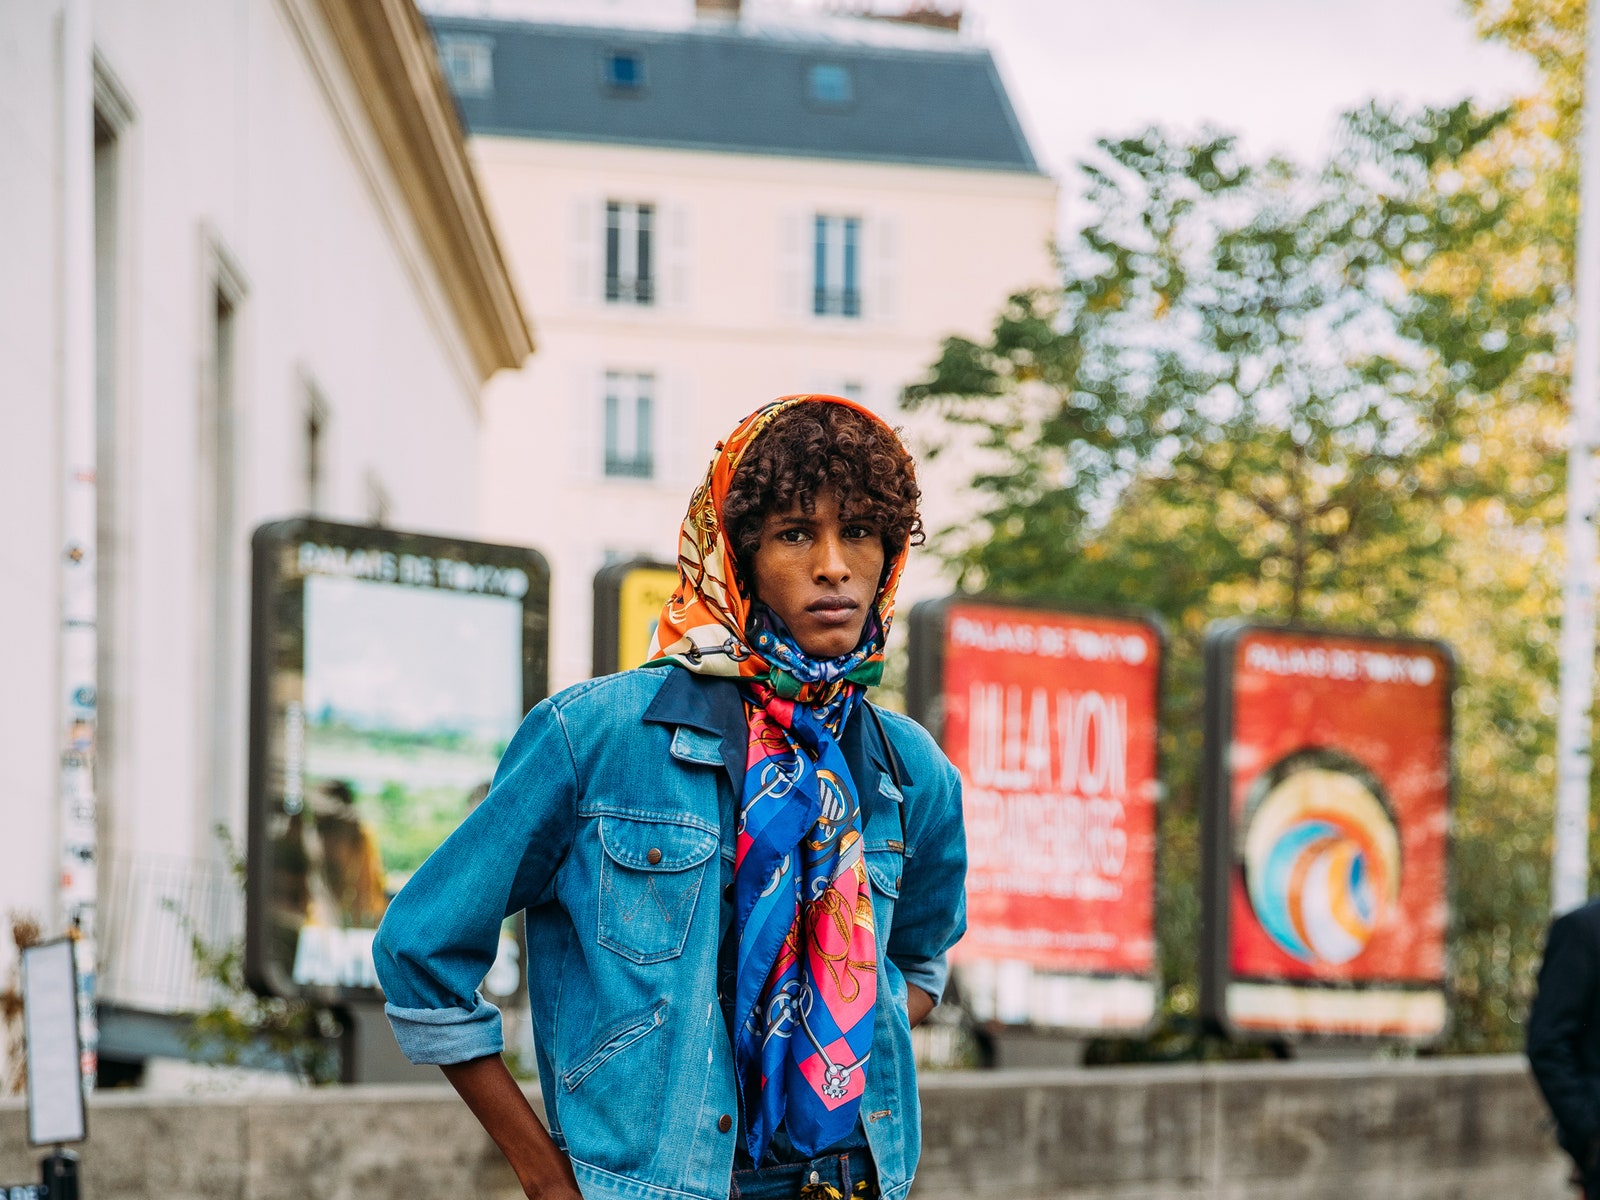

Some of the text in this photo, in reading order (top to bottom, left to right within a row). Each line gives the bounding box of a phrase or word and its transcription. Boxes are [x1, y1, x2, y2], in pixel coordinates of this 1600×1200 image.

[298, 541, 529, 600] PALAIS DE TOKYO
